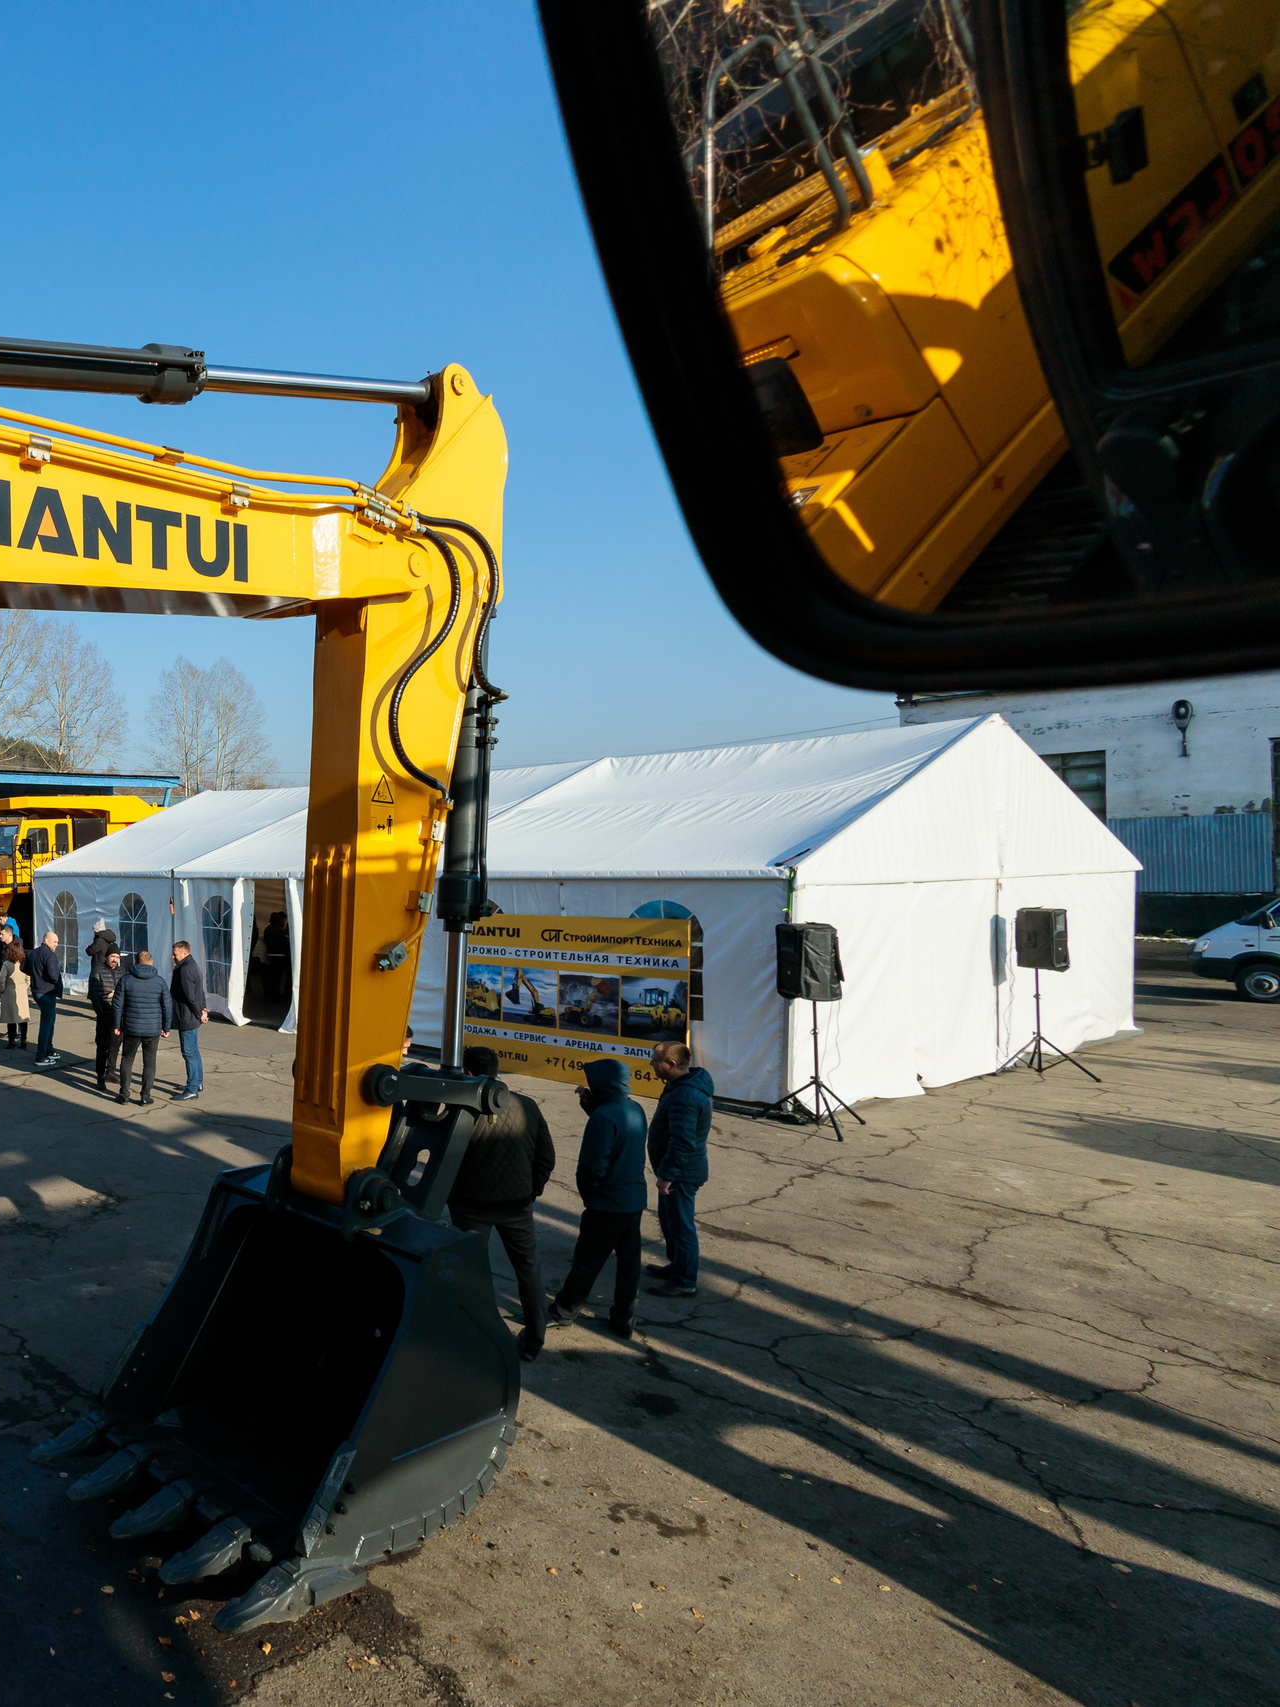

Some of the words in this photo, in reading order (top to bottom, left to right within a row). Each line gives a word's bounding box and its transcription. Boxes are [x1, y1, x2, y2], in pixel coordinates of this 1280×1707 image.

[616, 955, 680, 968] ТЕХНИКА
[513, 1032, 547, 1044] СЕРВИС
[565, 1038, 604, 1052] АРЕНДА
[623, 1046, 652, 1059] ЗАПЧ
